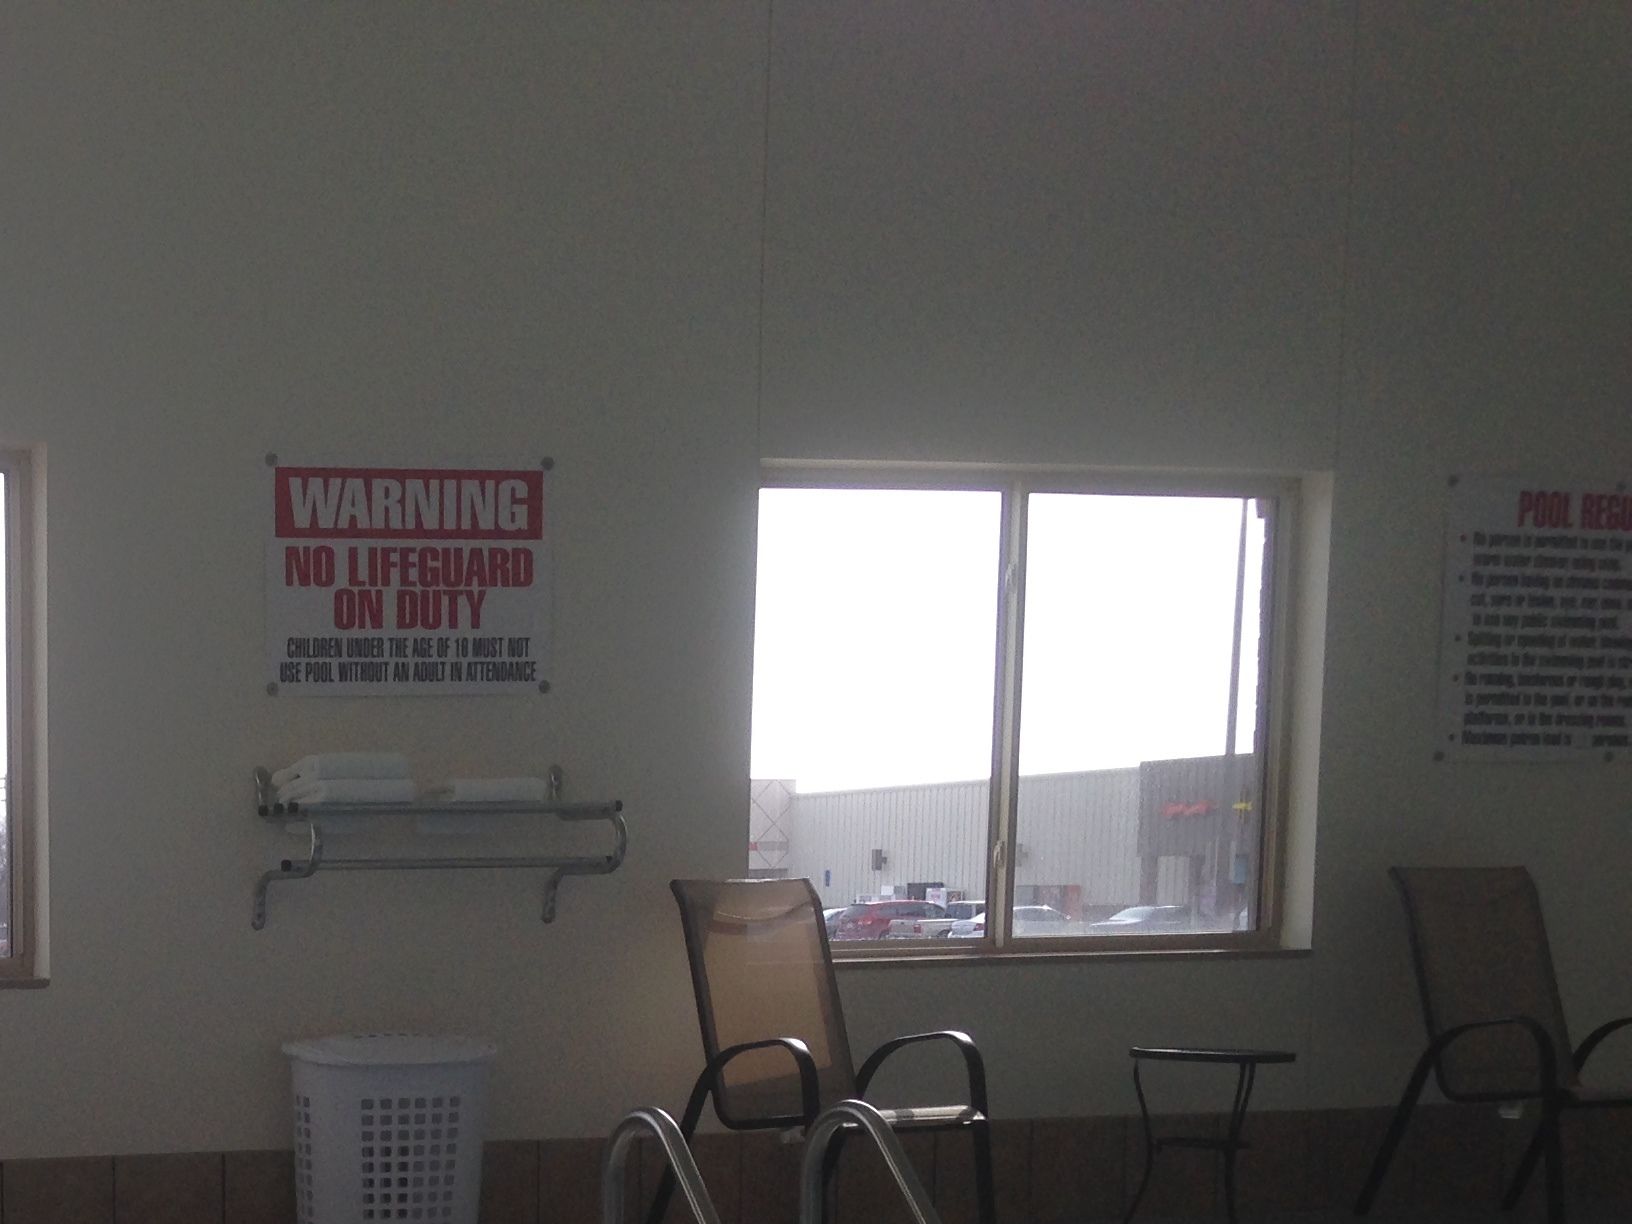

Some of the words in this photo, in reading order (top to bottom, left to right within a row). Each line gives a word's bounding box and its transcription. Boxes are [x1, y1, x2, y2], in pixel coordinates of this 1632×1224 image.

[288, 476, 529, 531] WARNING
[1517, 491, 1573, 528] POOL
[284, 546, 335, 587] NO
[348, 547, 534, 588] LIFEGUARD
[333, 588, 384, 630] ON
[396, 589, 487, 630] DUTY
[287, 637, 342, 658] CHILDREN
[346, 637, 384, 658] UNDER
[387, 637, 409, 658] THE
[412, 637, 433, 658] AGE
[436, 637, 450, 658] OF
[472, 637, 503, 658] MUST
[507, 637, 530, 658] NOT
[279, 661, 302, 682] USE
[305, 661, 334, 682] POOL
[338, 661, 389, 682] WITHOUT
[392, 661, 410, 682] AN
[413, 661, 446, 682] ADULT
[450, 661, 463, 682] IN
[465, 661, 536, 682] ATTENDANCE
